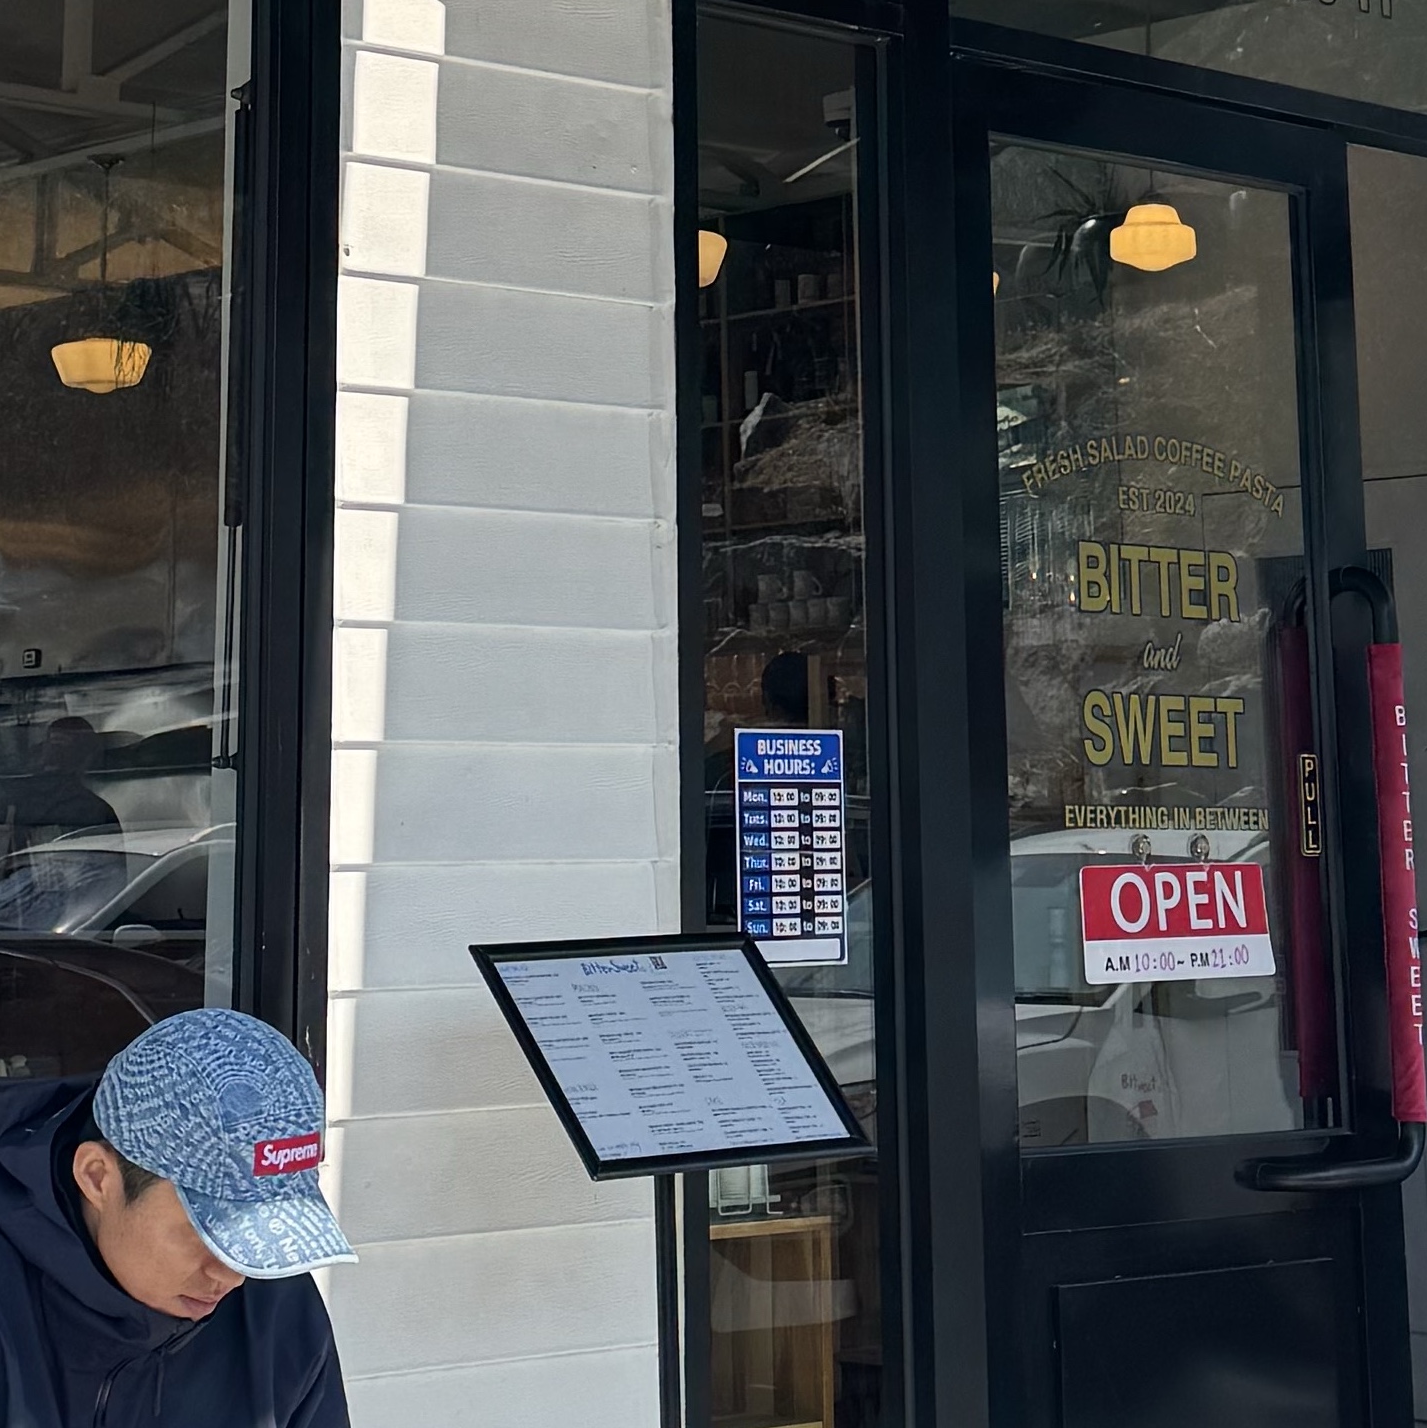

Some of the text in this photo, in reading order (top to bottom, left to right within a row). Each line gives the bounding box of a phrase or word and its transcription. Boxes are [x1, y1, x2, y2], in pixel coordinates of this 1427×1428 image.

[1021, 435, 1285, 519] FRESH SALAD COFFEE PASTA
[1119, 487, 1196, 517] EST 2024
[1078, 541, 1240, 622] BITTER
[1143, 632, 1182, 671] and
[757, 739, 821, 755] BUSINESS
[1082, 690, 1245, 768] SWEET
[764, 759, 816, 775] HOURS:
[743, 791, 768, 802] Mon.
[1304, 758, 1317, 851] PULL
[1065, 804, 1269, 831] EVERYTHING IN BETWEEN
[1110, 870, 1248, 934] OPEN
